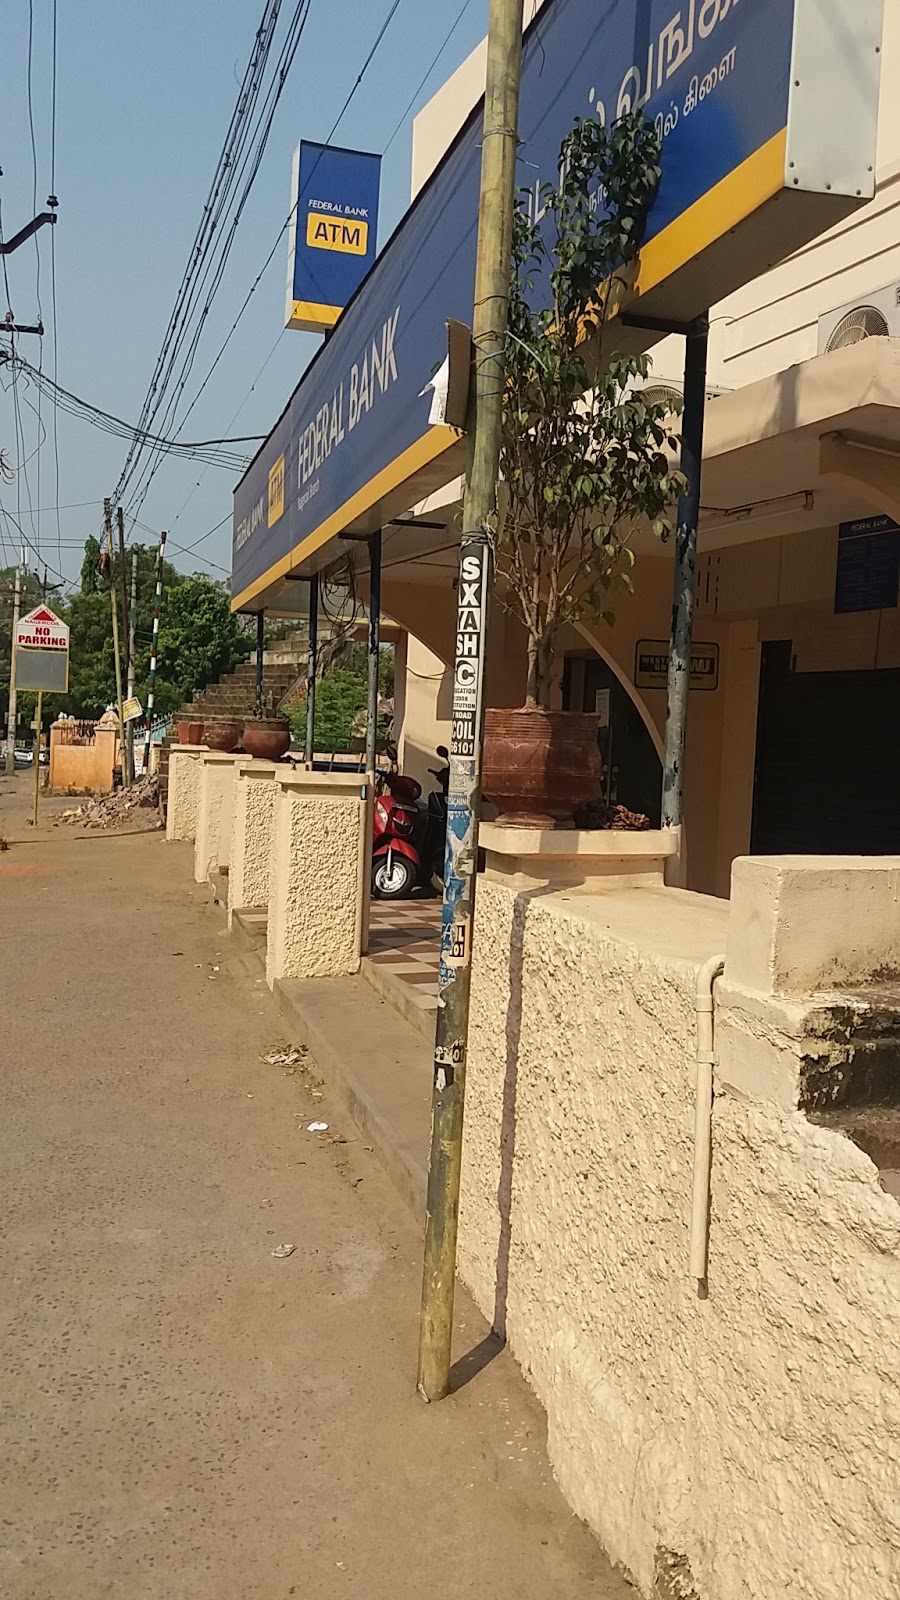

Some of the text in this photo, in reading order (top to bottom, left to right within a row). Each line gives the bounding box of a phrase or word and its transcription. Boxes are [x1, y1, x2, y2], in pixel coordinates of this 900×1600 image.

[308, 199, 369, 218] FEDERAL BANK
[314, 221, 361, 247] ATM
[298, 305, 401, 490] FEDERAL BANK
[35, 627, 51, 636] NO
[18, 635, 67, 647] PARKING
[455, 711, 473, 720] ROAD
